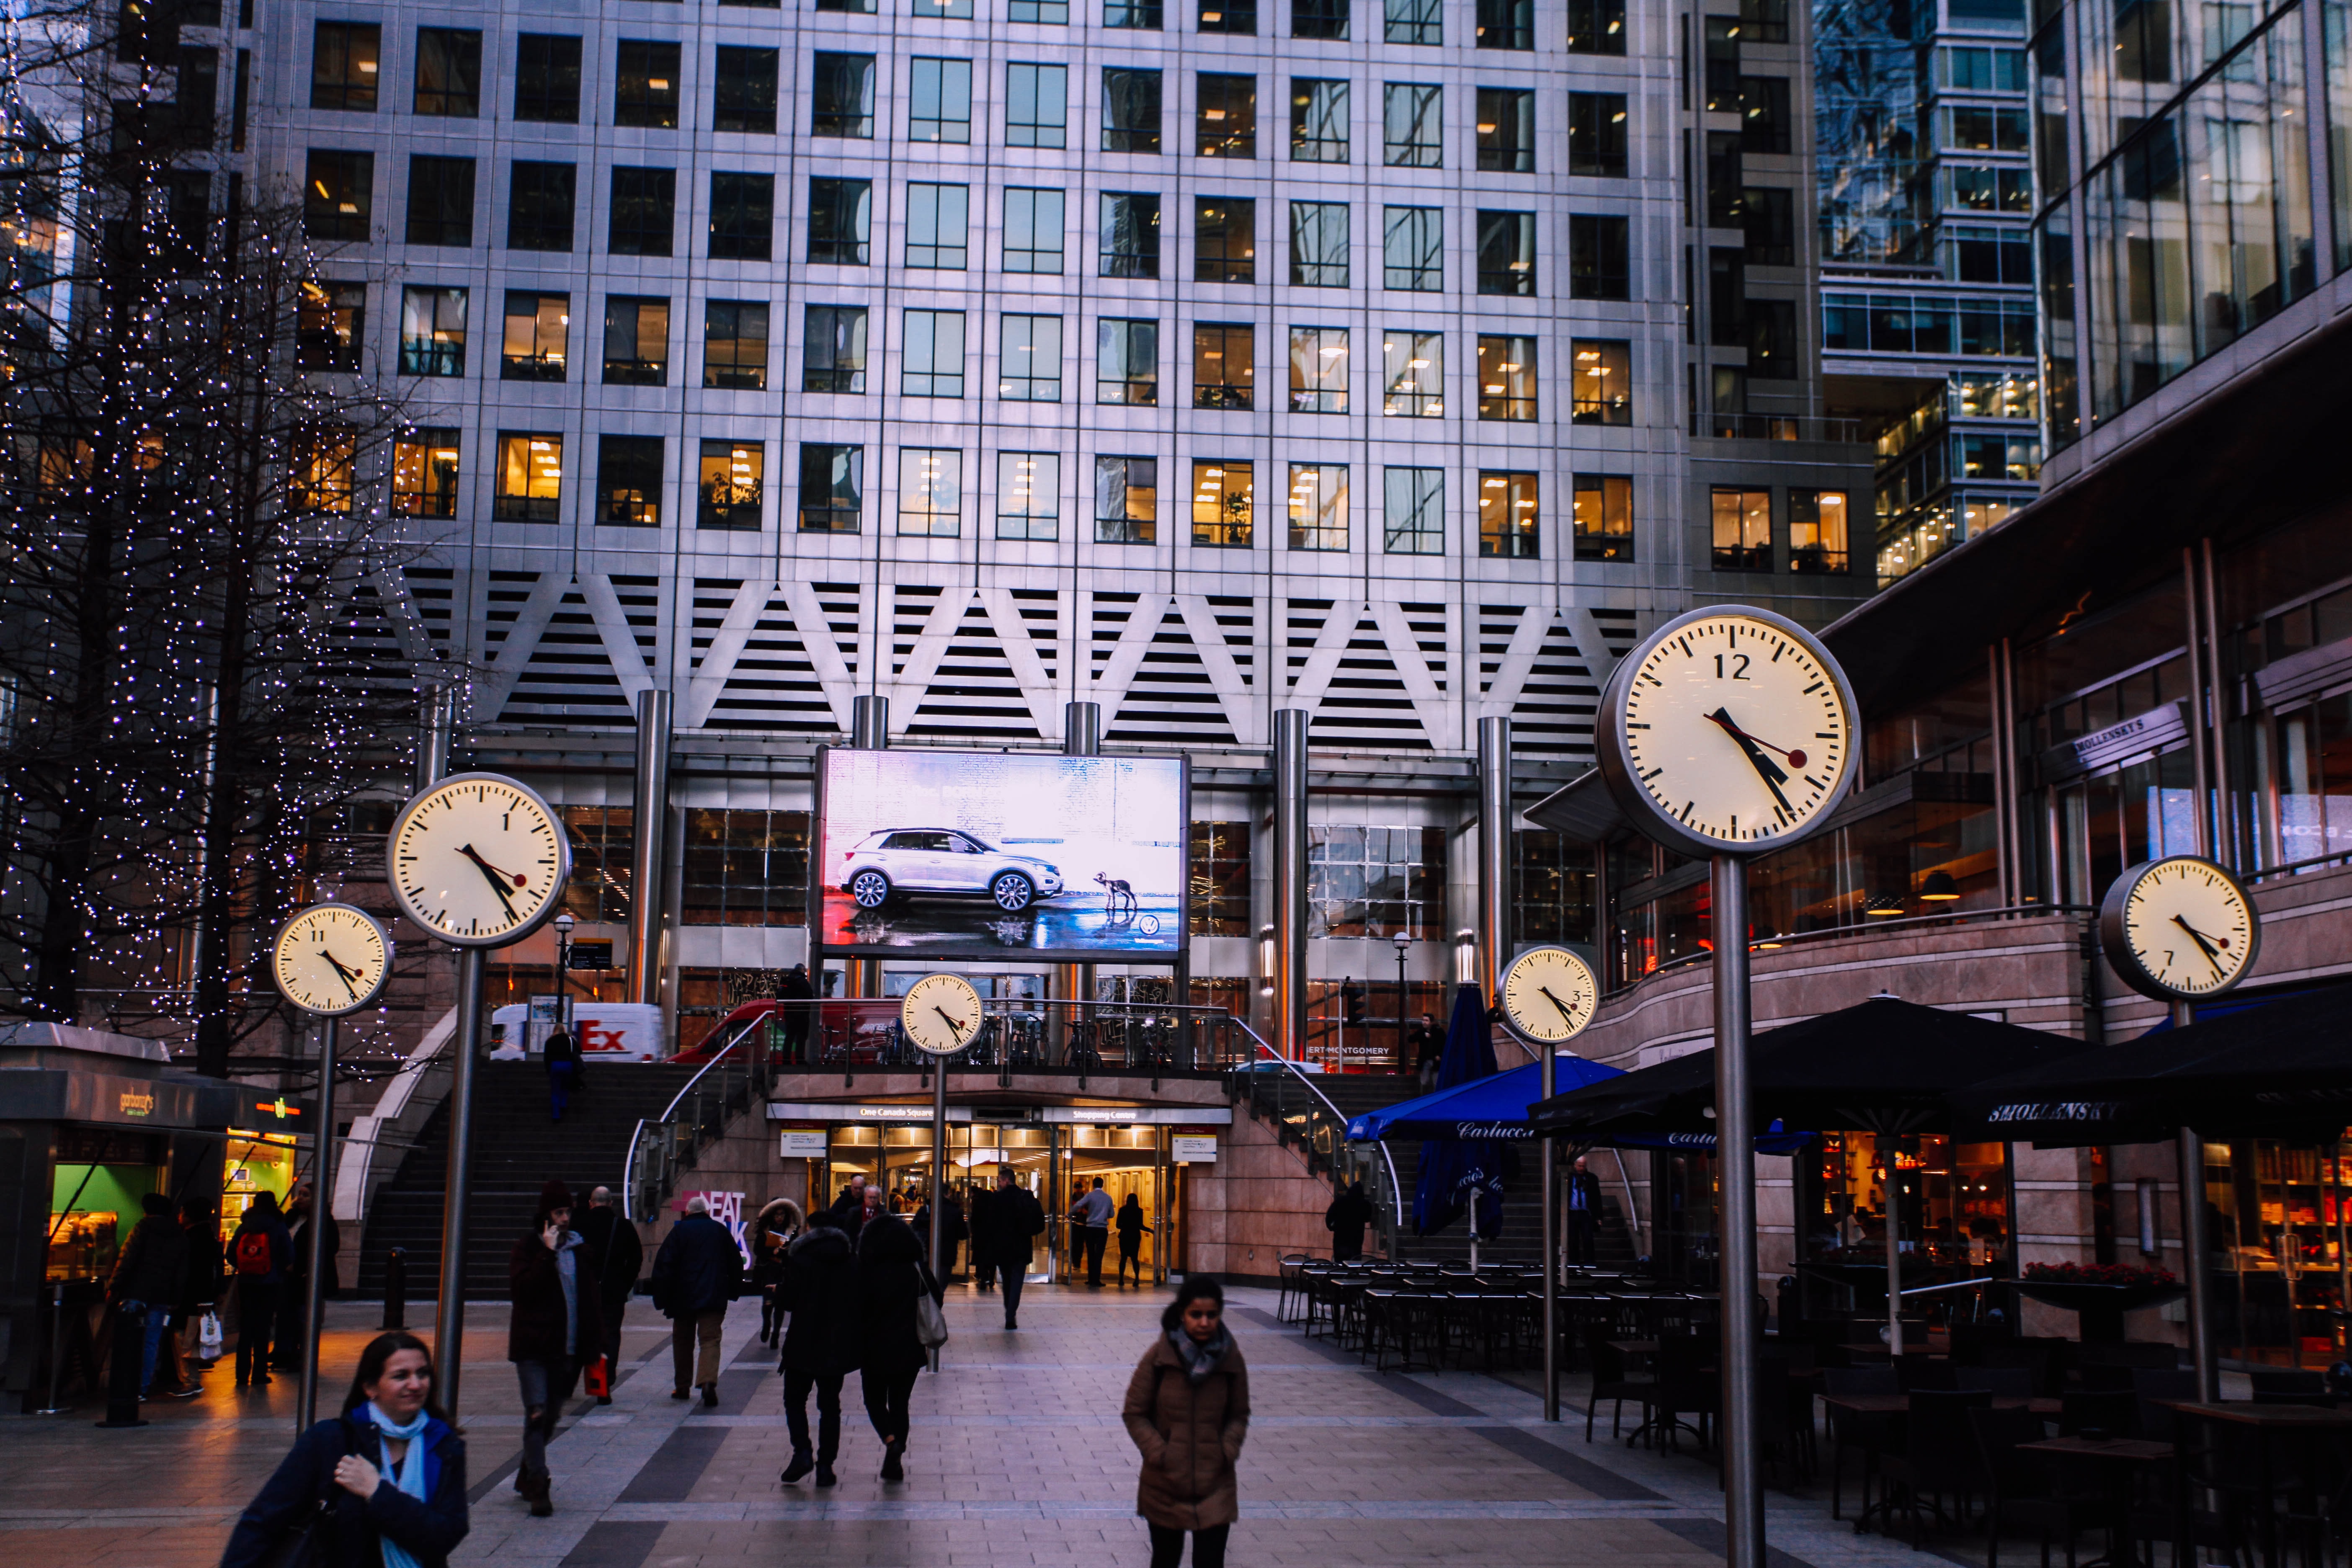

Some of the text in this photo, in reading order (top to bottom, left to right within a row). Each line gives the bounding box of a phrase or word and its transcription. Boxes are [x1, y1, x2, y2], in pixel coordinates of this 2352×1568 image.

[1713, 653, 1751, 681] 12
[502, 813, 509, 831] 1
[311, 930, 324, 942] 11
[2164, 950, 2174, 966] 7
[1573, 990, 1580, 1001] 3
[859, 1108, 934, 1118] One Canada Square
[1073, 1110, 1110, 1120] Shopping
